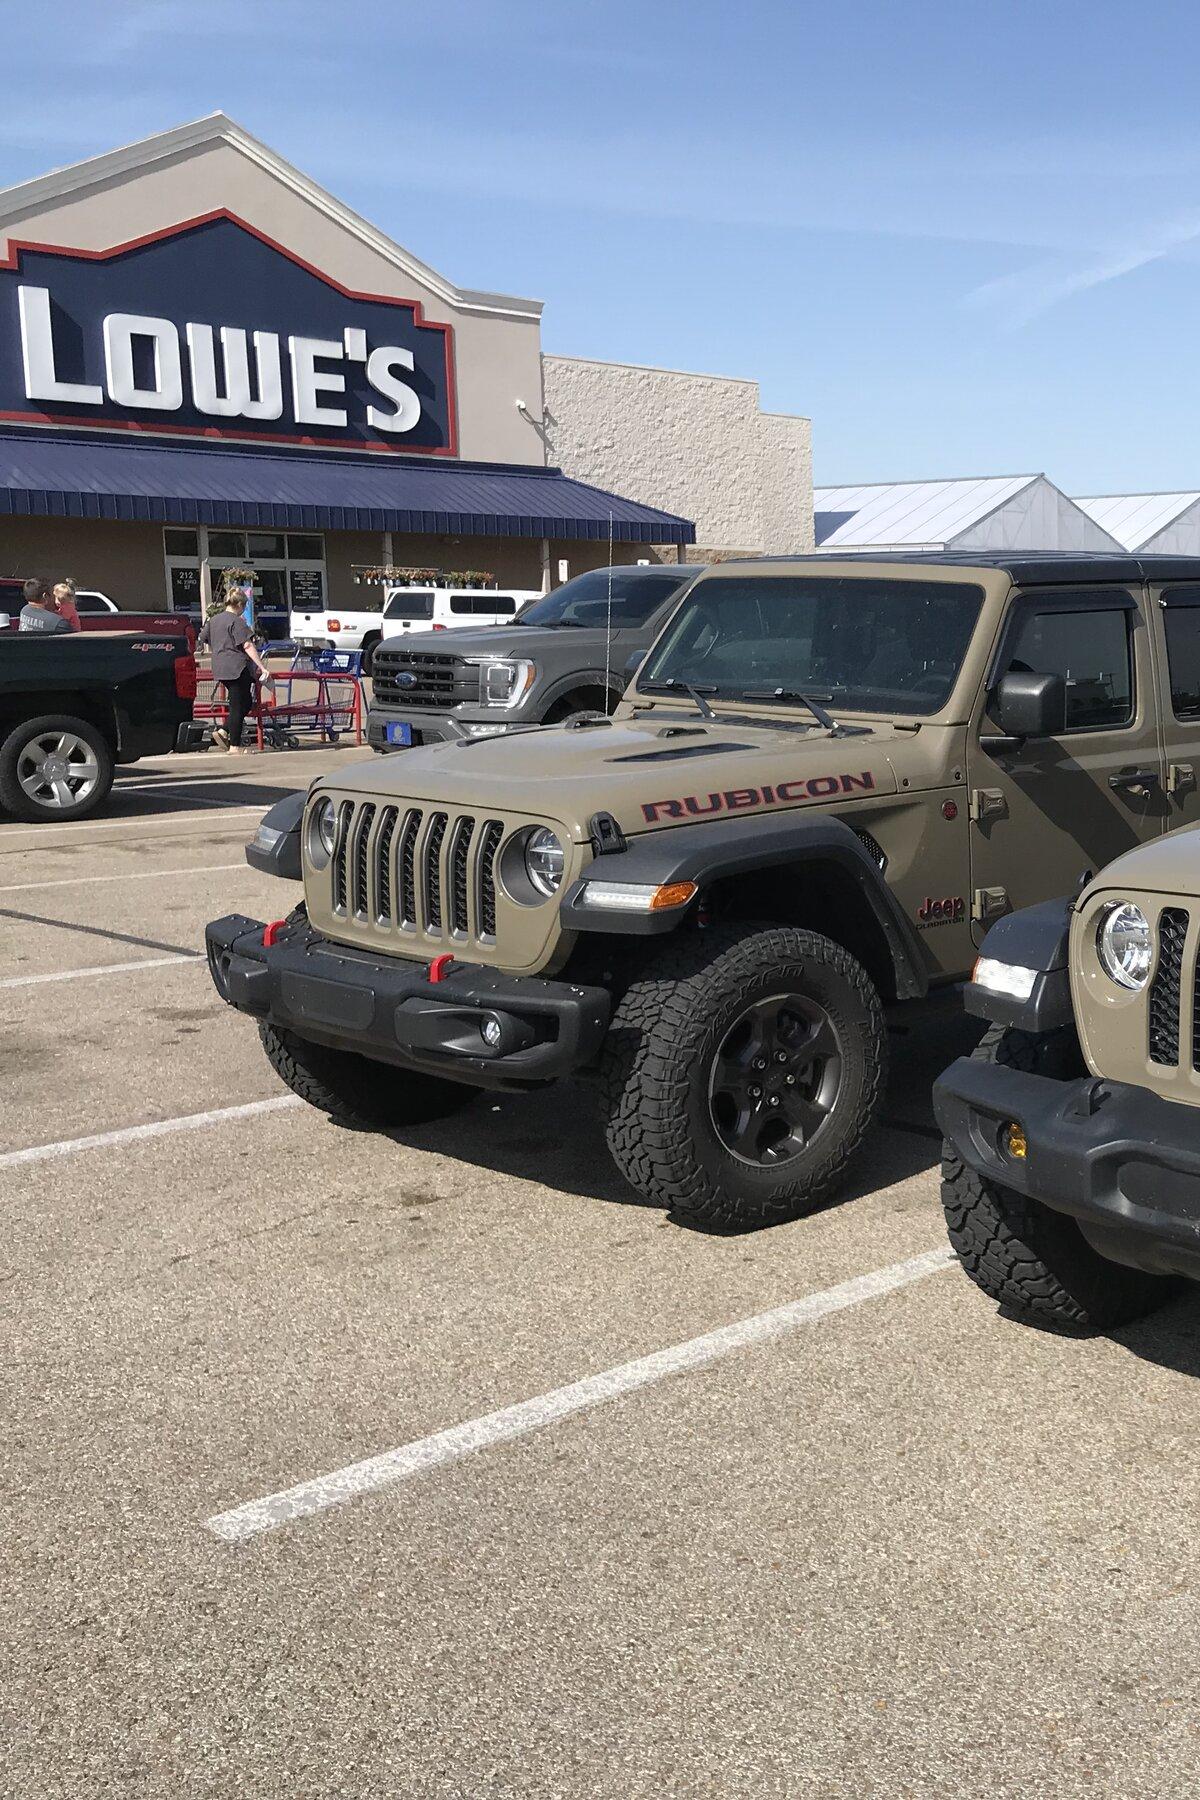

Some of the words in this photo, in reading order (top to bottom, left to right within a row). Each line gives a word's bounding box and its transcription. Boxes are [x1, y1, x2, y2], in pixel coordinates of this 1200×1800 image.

[18, 285, 421, 433] LOWE'S
[179, 571, 194, 579] 212
[640, 771, 875, 824] RUBICON
[916, 896, 965, 920] Jeep
